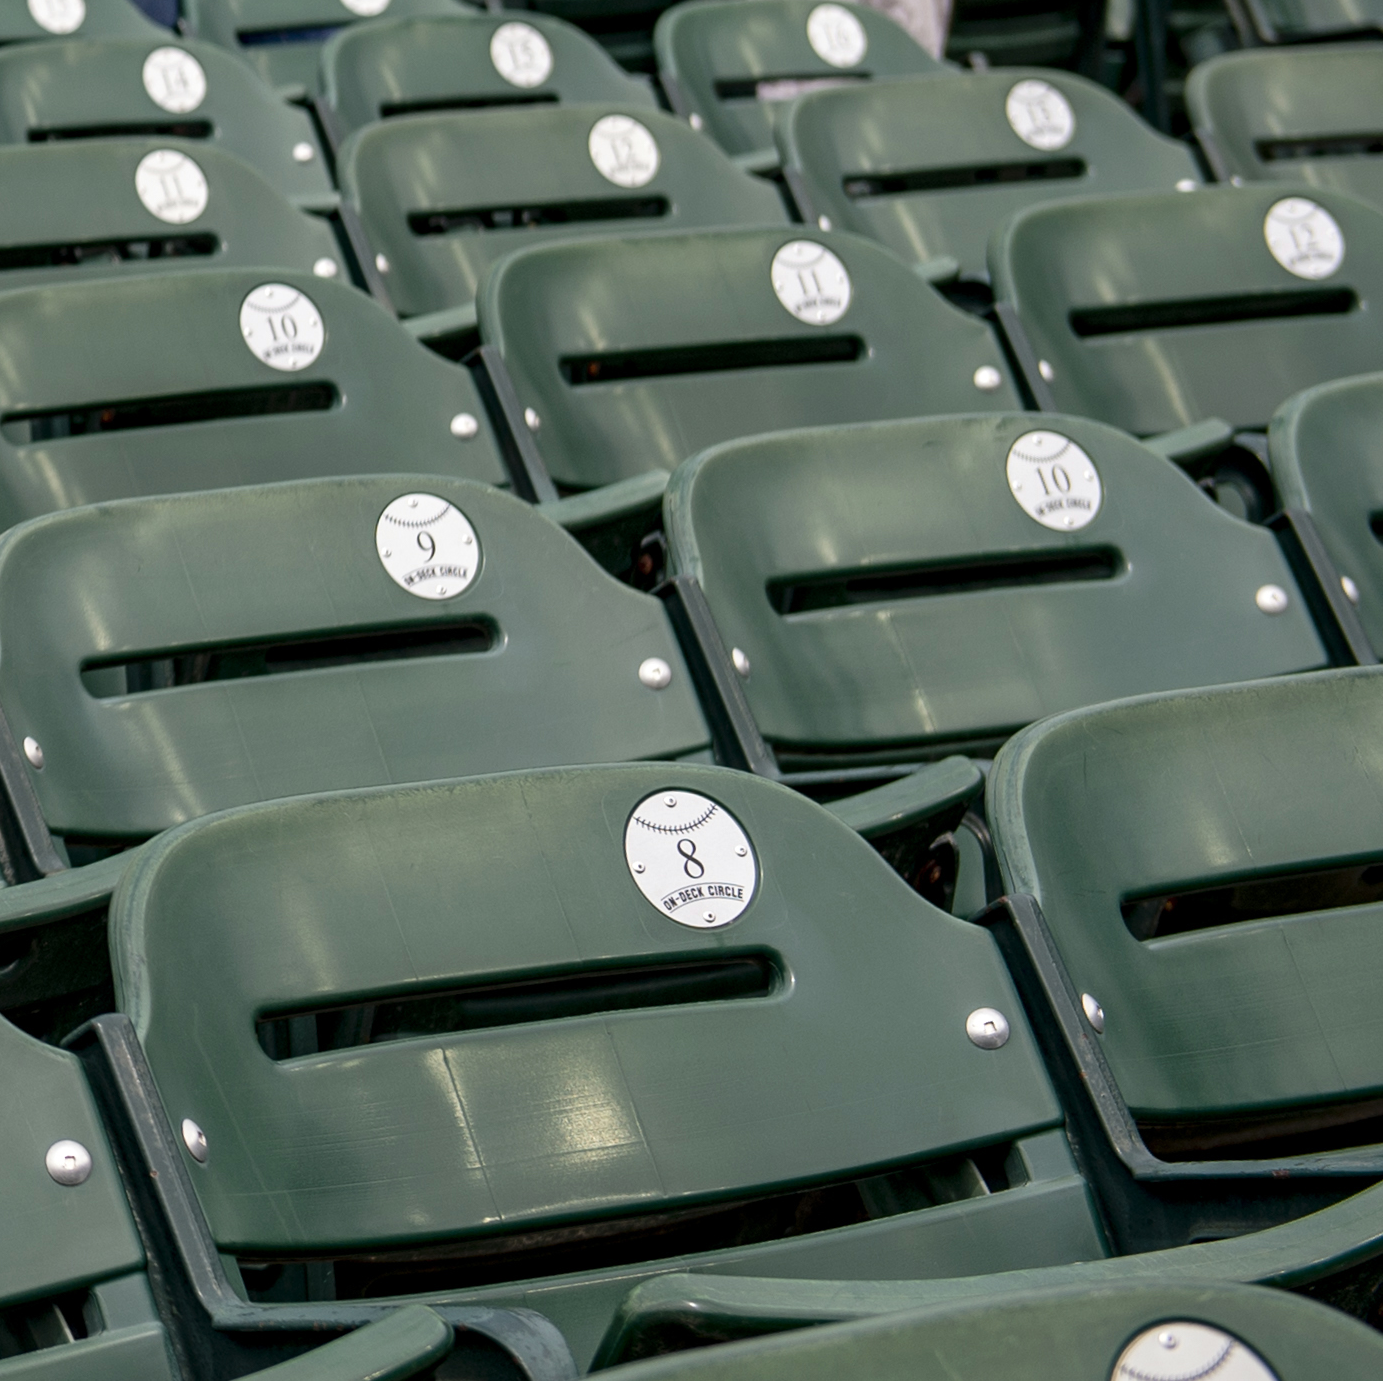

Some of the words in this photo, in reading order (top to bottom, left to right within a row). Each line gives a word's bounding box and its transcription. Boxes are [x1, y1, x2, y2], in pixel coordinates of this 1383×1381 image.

[796, 269, 822, 296] 11
[267, 313, 298, 342] 10
[1036, 464, 1071, 496] 10
[416, 530, 436, 563] 9
[676, 838, 705, 880] 8
[662, 887, 705, 911] ON-DECK
[707, 885, 744, 900] CIRCLE
